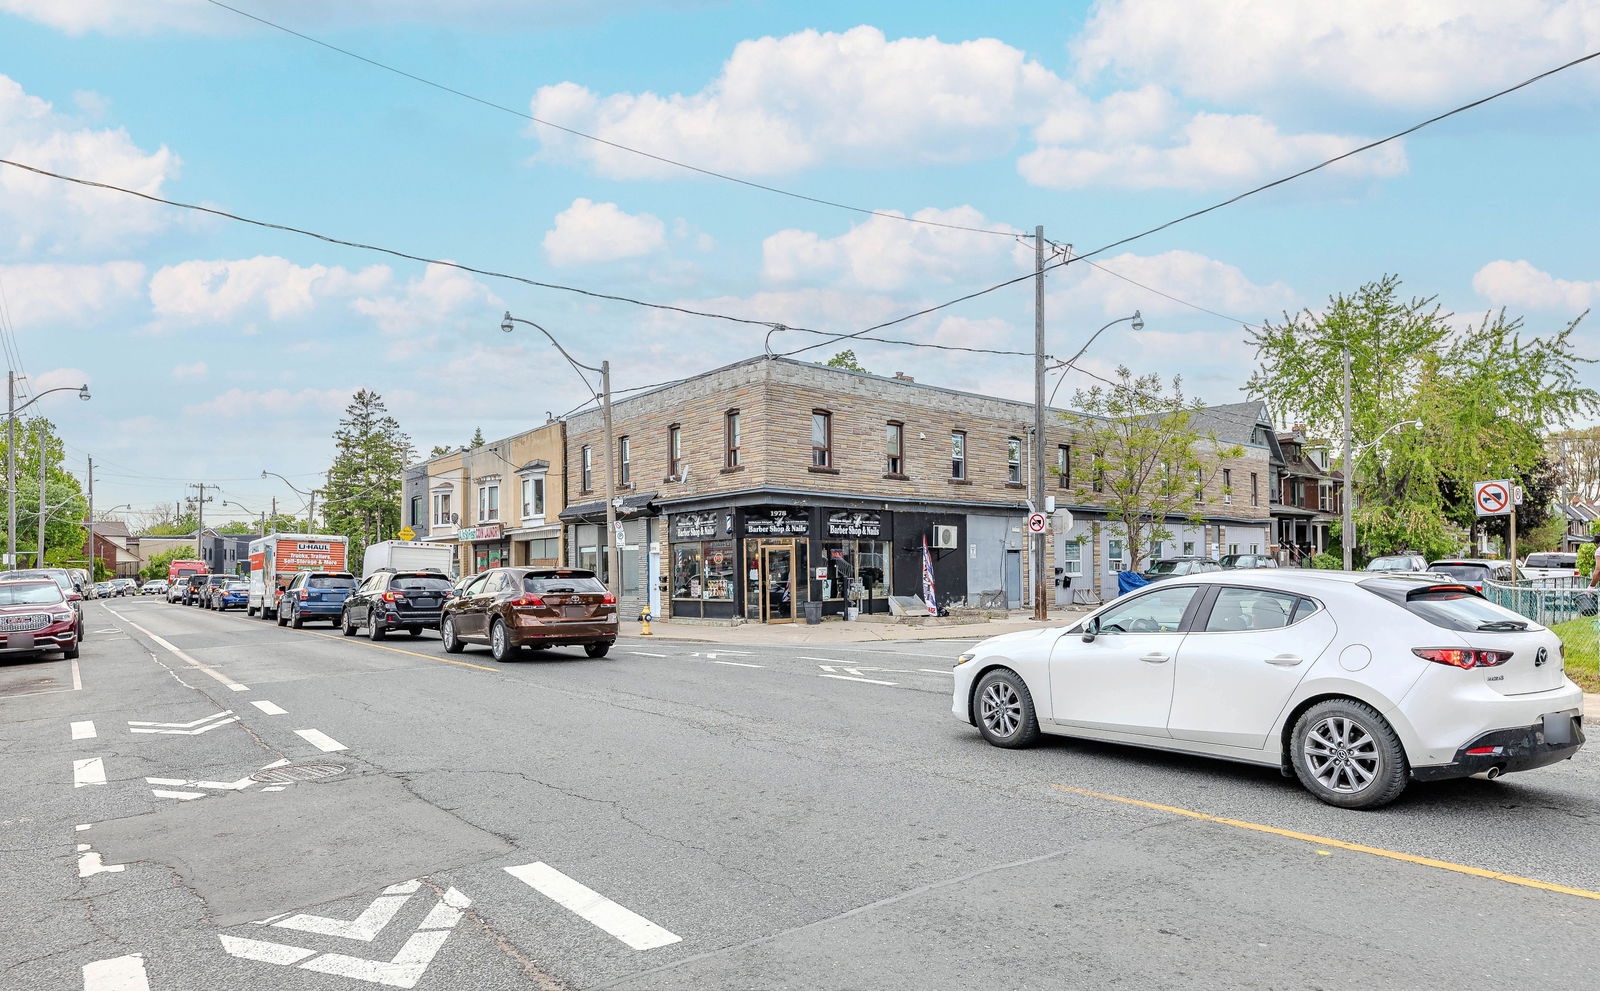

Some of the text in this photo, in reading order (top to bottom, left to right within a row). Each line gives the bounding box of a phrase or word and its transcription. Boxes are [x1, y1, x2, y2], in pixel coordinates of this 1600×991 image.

[748, 525, 769, 533] Barber
[769, 525, 785, 534] Shop
[791, 524, 807, 532] Nails
[829, 524, 880, 537] Barber Shop & Nails
